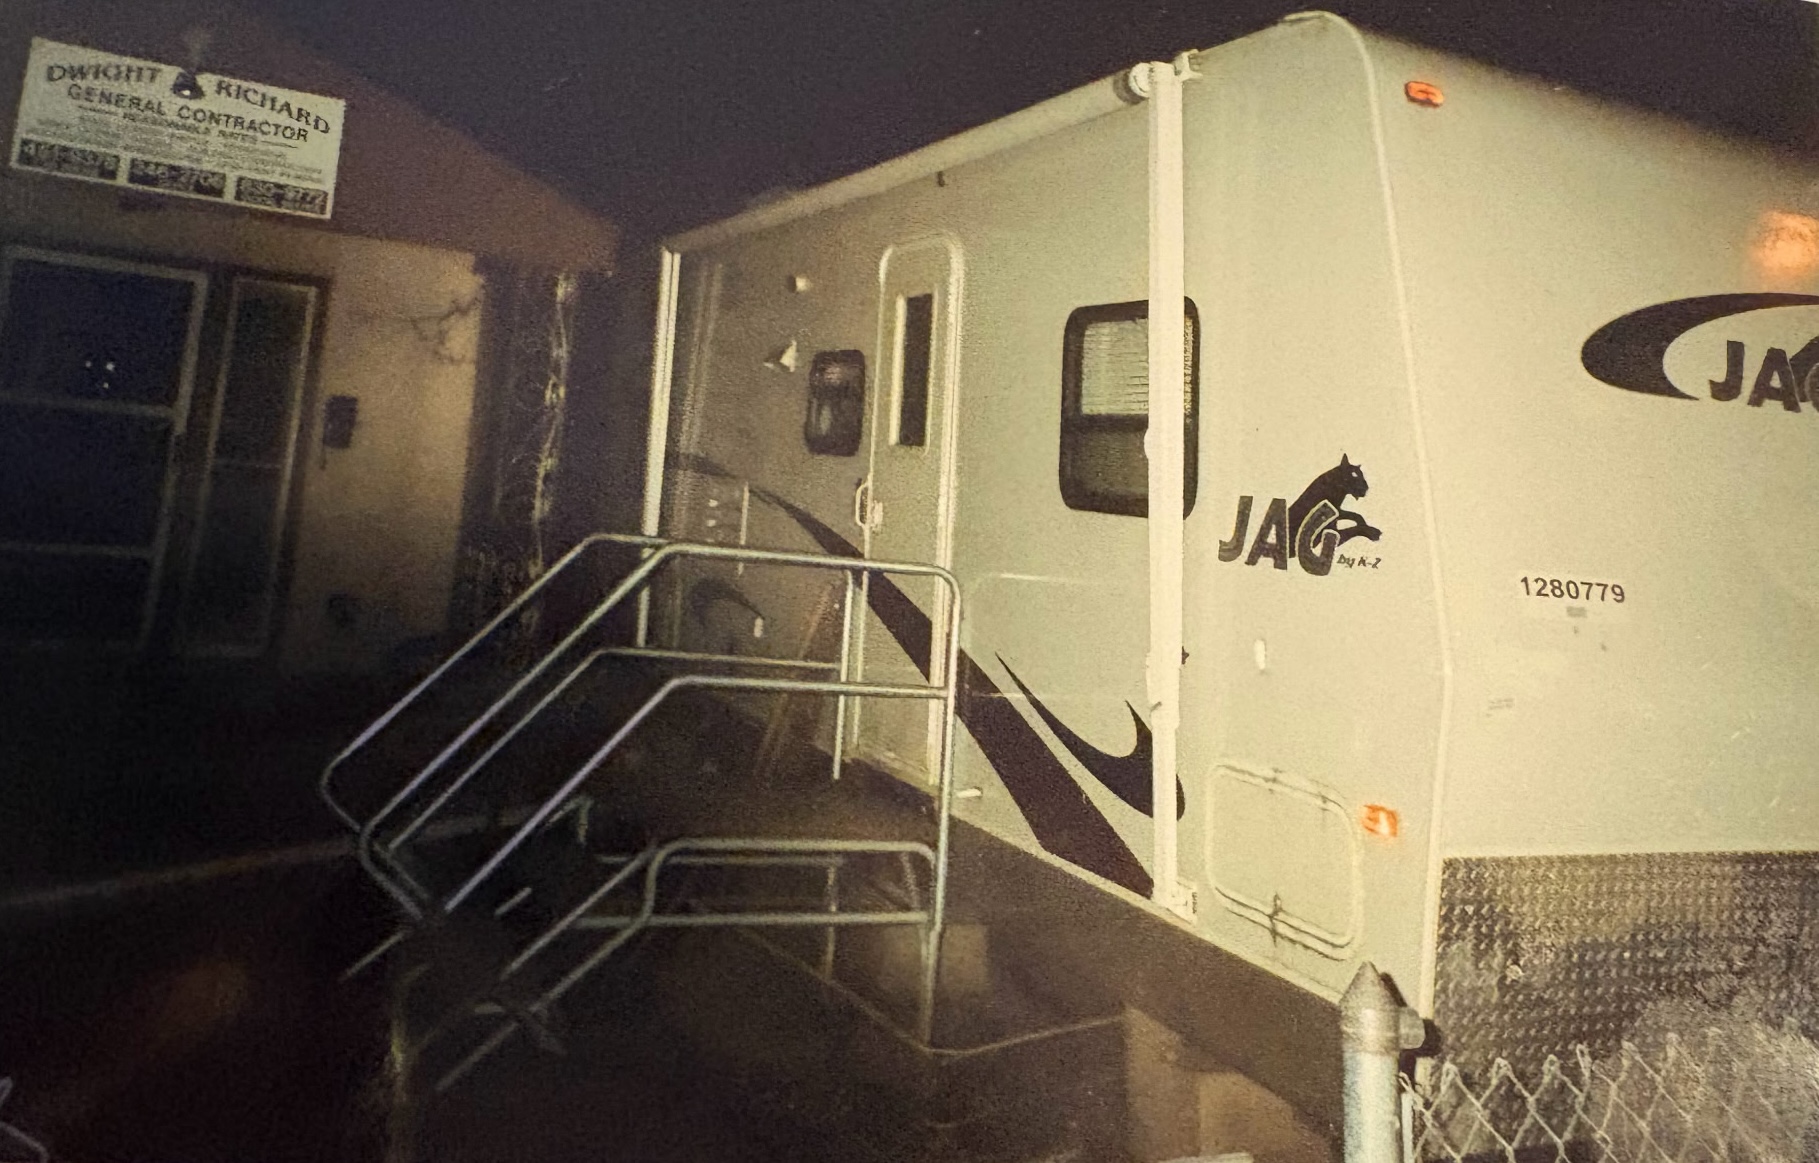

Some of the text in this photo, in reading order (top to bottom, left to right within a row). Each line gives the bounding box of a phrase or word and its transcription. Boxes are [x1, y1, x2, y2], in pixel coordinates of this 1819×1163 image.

[47, 64, 162, 83] DWIGHT
[215, 80, 331, 134] RICHARD
[68, 83, 166, 116] GENERAL
[177, 104, 309, 143] CONTRACTOR
[1218, 495, 1340, 576] JAG
[1520, 576, 1626, 604] 1280779
